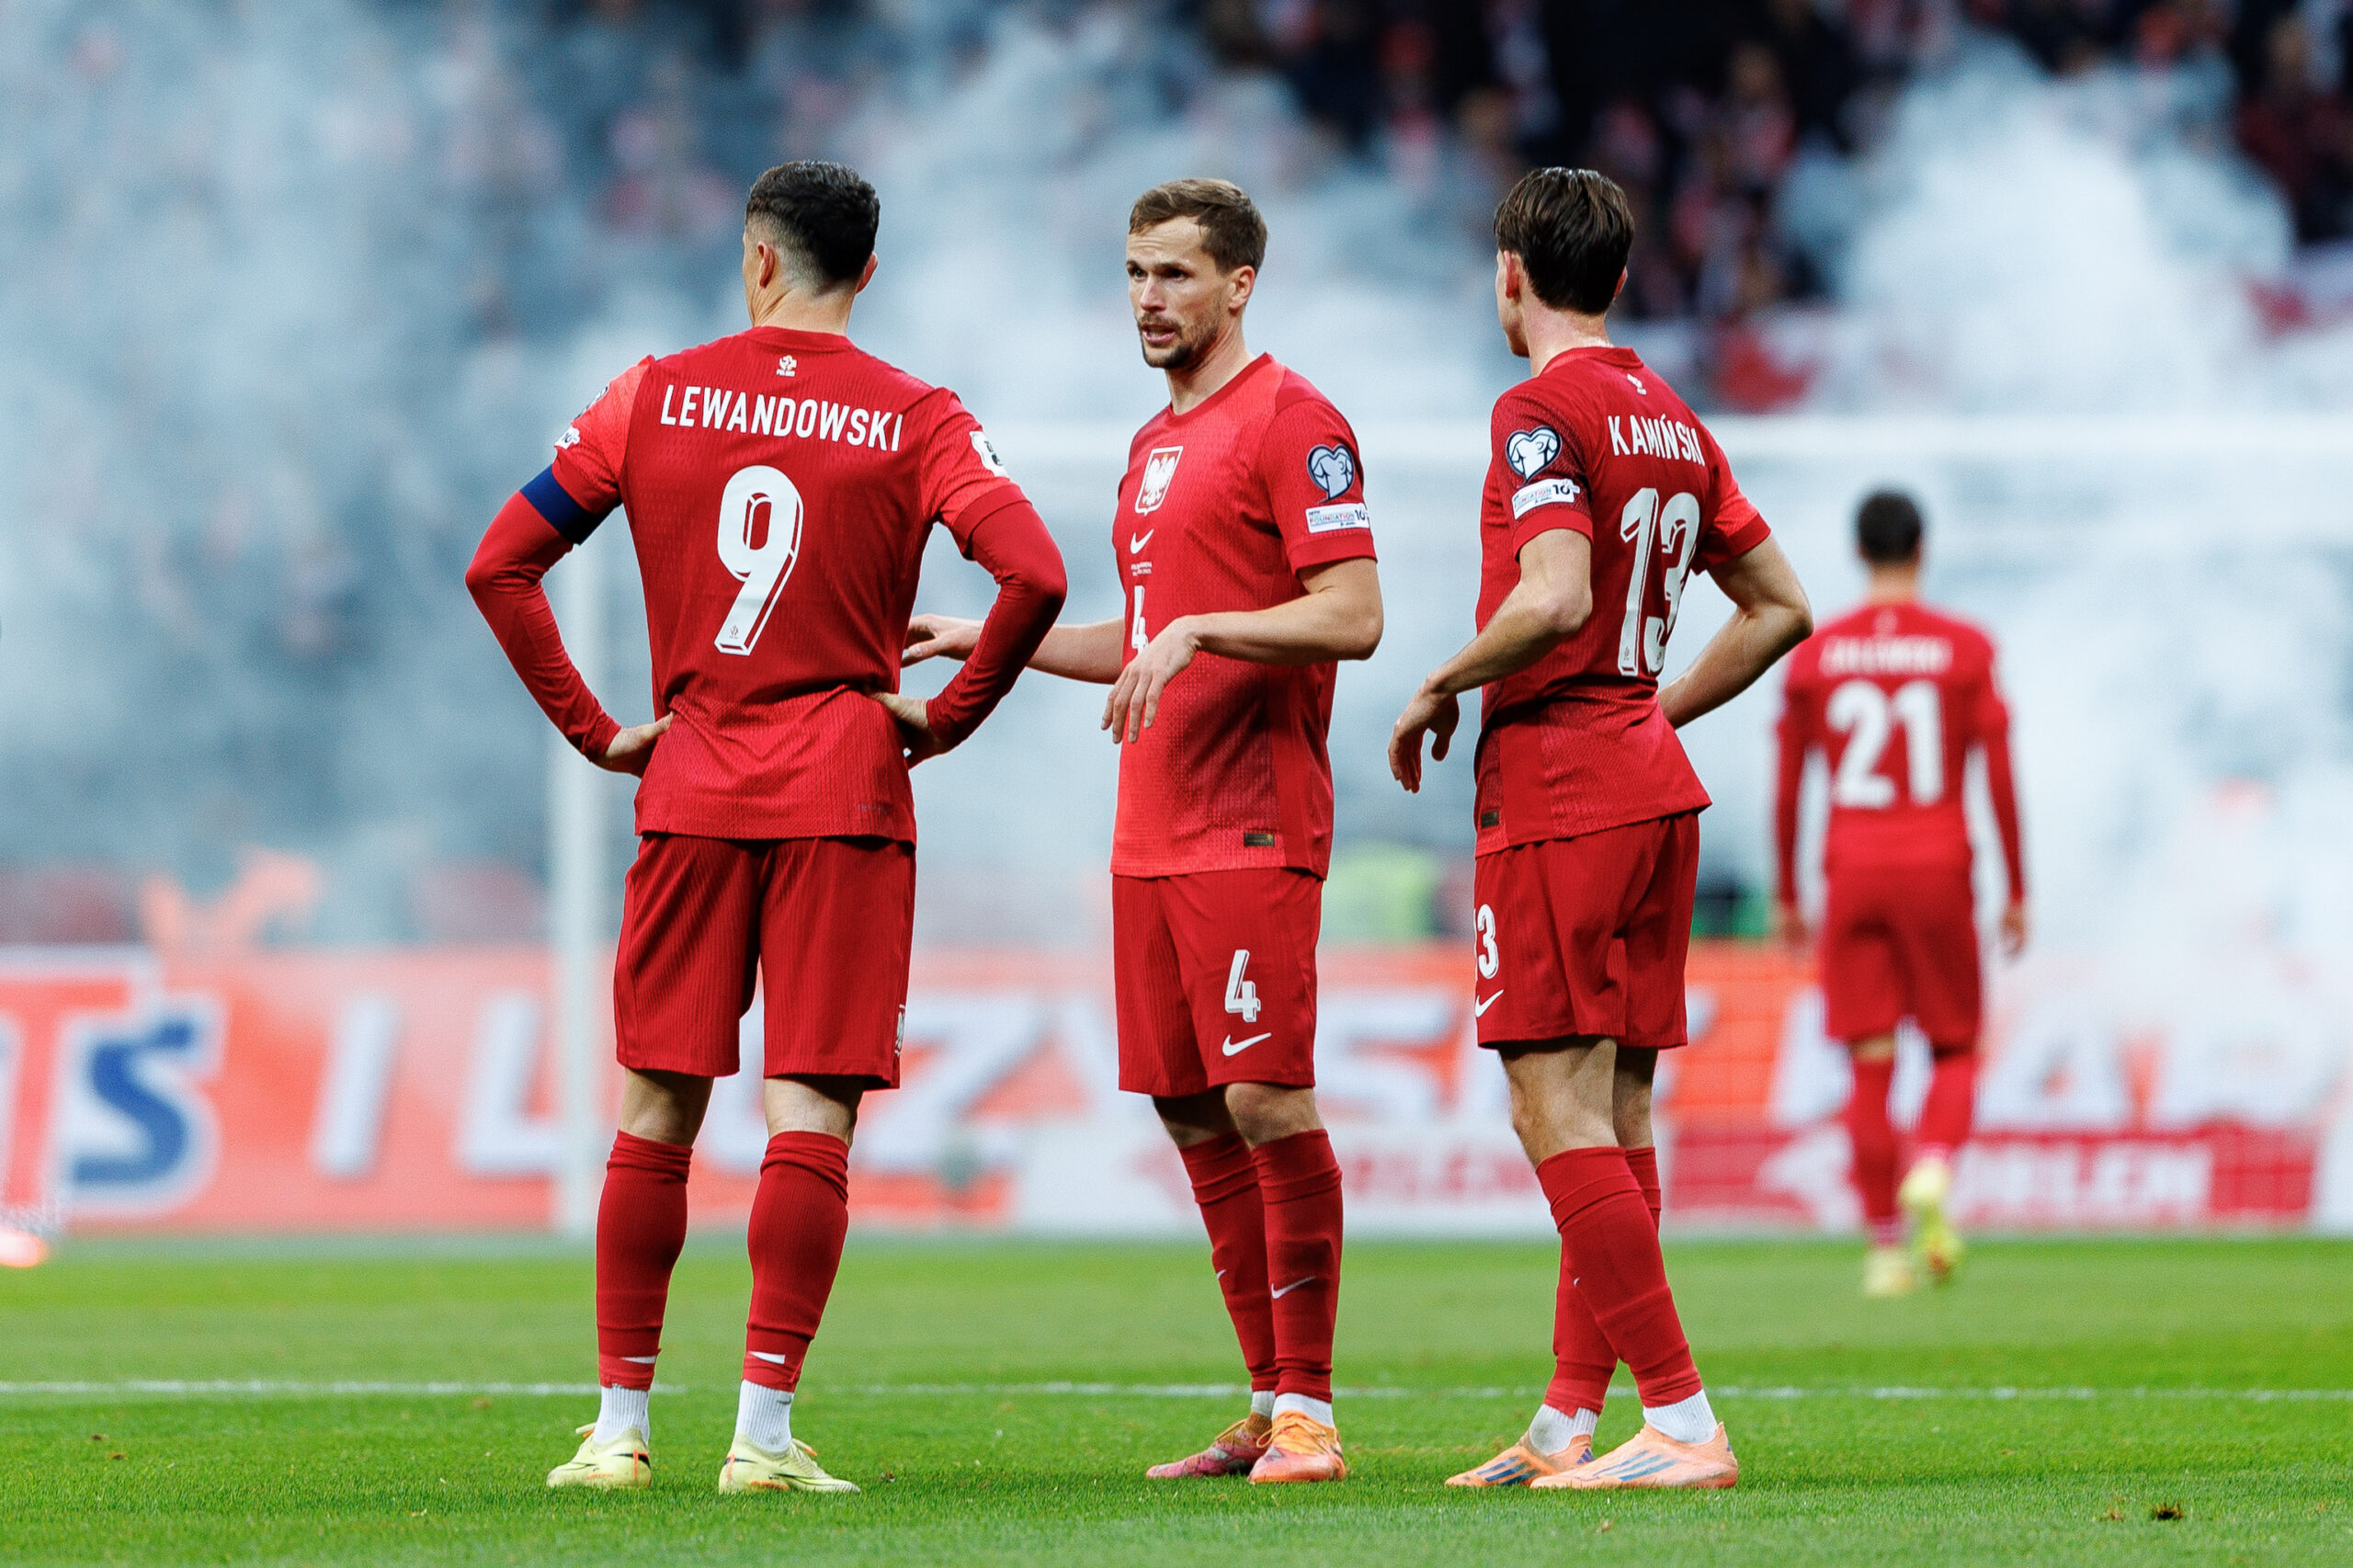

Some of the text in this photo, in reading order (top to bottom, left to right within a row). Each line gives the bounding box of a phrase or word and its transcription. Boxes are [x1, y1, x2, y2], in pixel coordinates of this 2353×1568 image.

[660, 384, 904, 452] LEWANDOWSKI
[714, 465, 803, 655] 9
[1620, 487, 1700, 676] 13
[1131, 585, 1149, 654] 4
[1825, 680, 1946, 809] 21
[1473, 903, 1499, 981] 3
[1224, 949, 1262, 1023] 4
